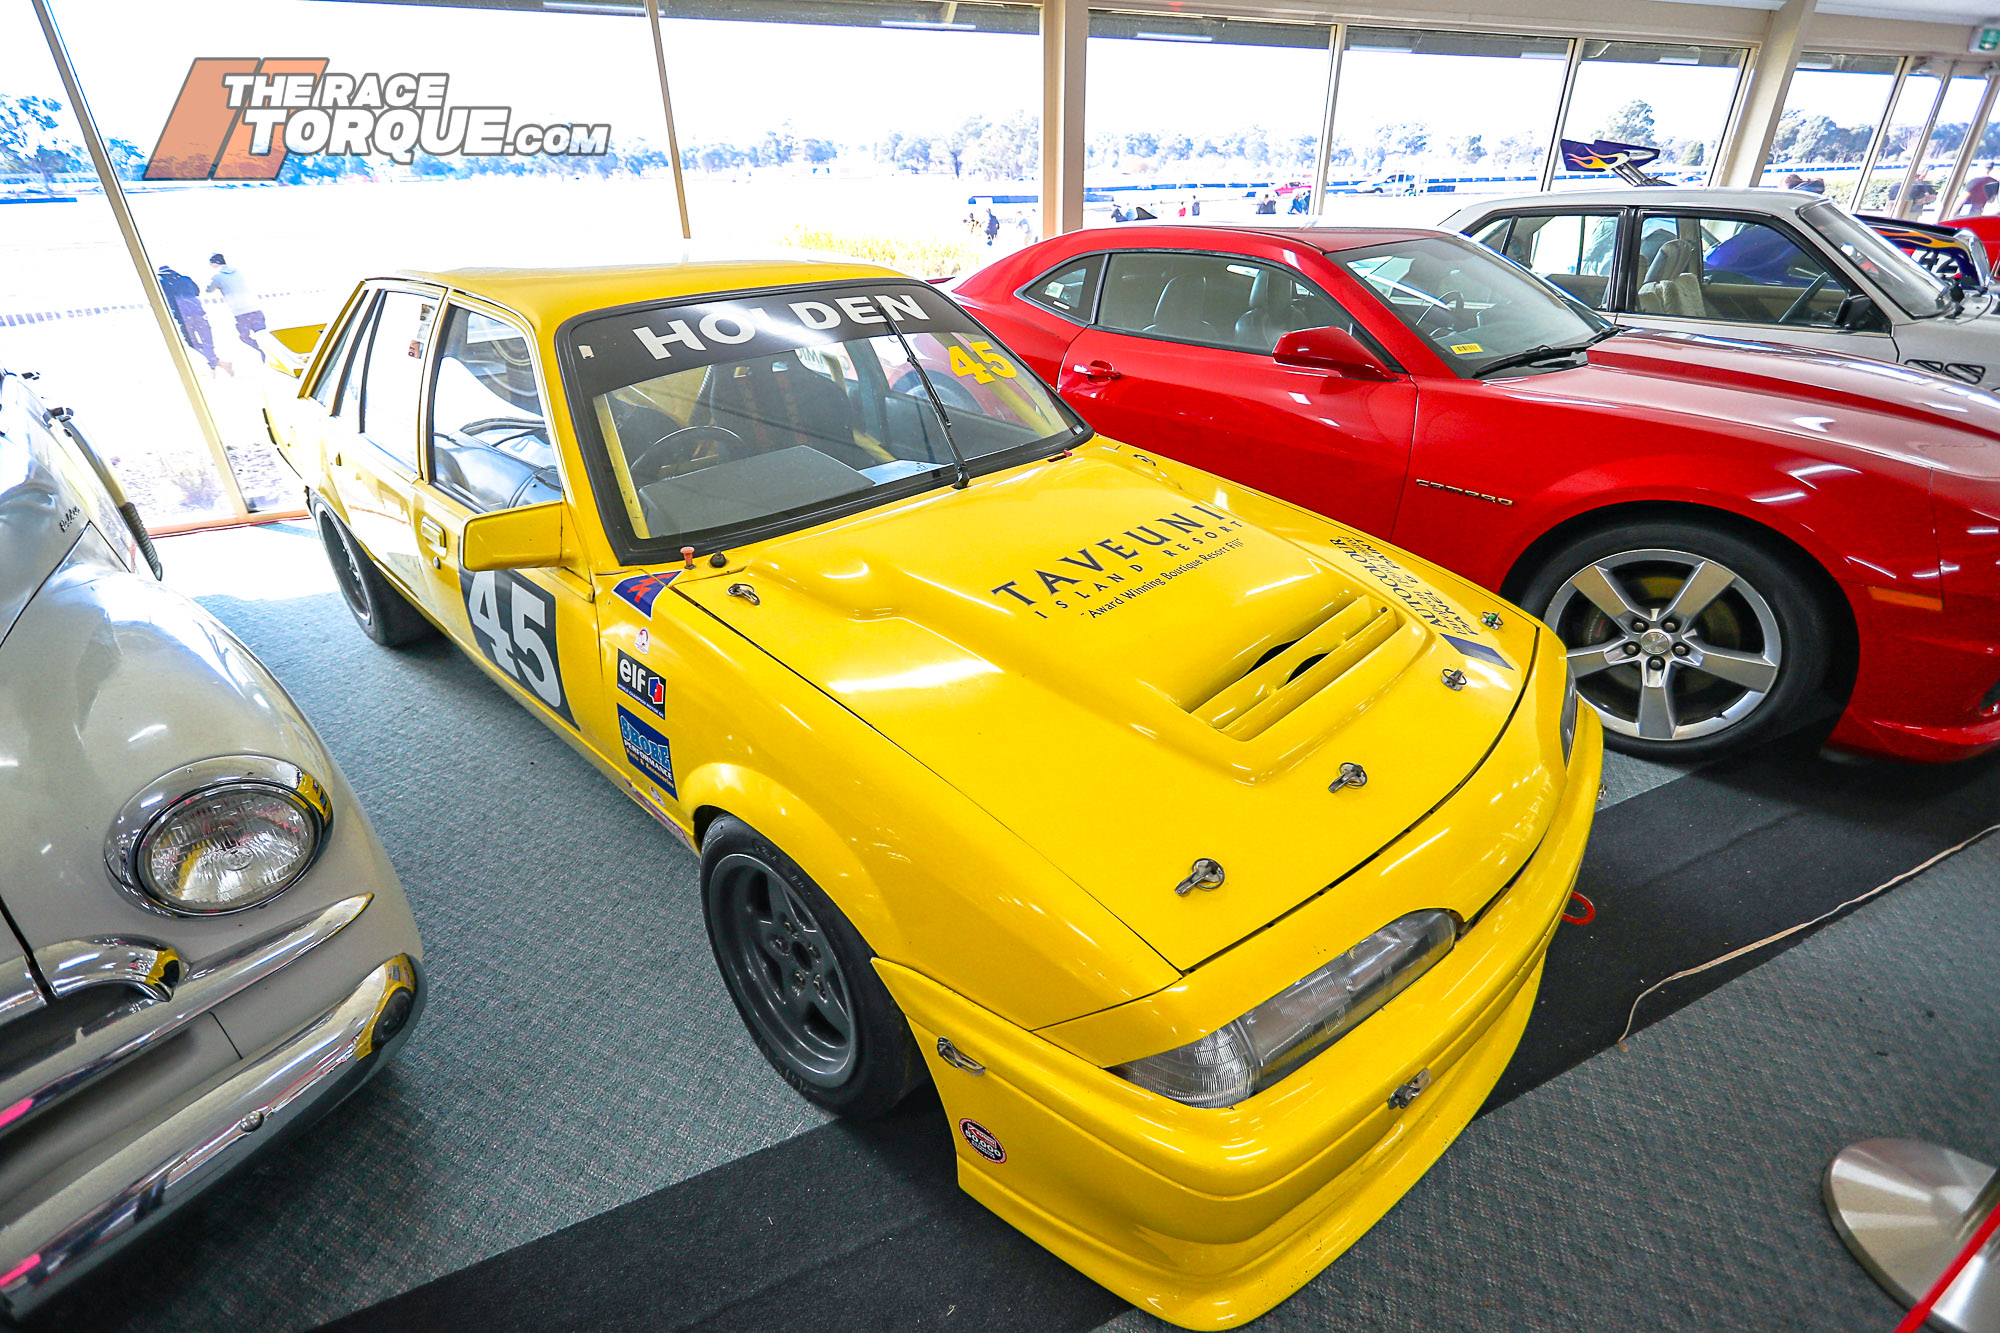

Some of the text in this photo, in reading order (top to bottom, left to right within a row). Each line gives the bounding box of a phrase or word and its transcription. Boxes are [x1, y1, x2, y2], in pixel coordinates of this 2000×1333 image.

[632, 294, 932, 361] HOLDEN
[947, 340, 1018, 386] 45
[1415, 478, 1513, 506] CAMARO
[990, 504, 1226, 606] TAVEUNI
[1034, 520, 1243, 619] ISLAND RESORT
[1120, 576, 1166, 601] Winning
[1160, 558, 1203, 581] Boutique
[1199, 544, 1230, 563] Resort
[1350, 536, 1400, 570] PAINT
[1329, 538, 1449, 630] AUTOCOLOUR
[1423, 588, 1479, 636] PANEL
[468, 570, 561, 707] 45
[619, 658, 646, 693] elf
[623, 739, 673, 781] PERFORMANCE
